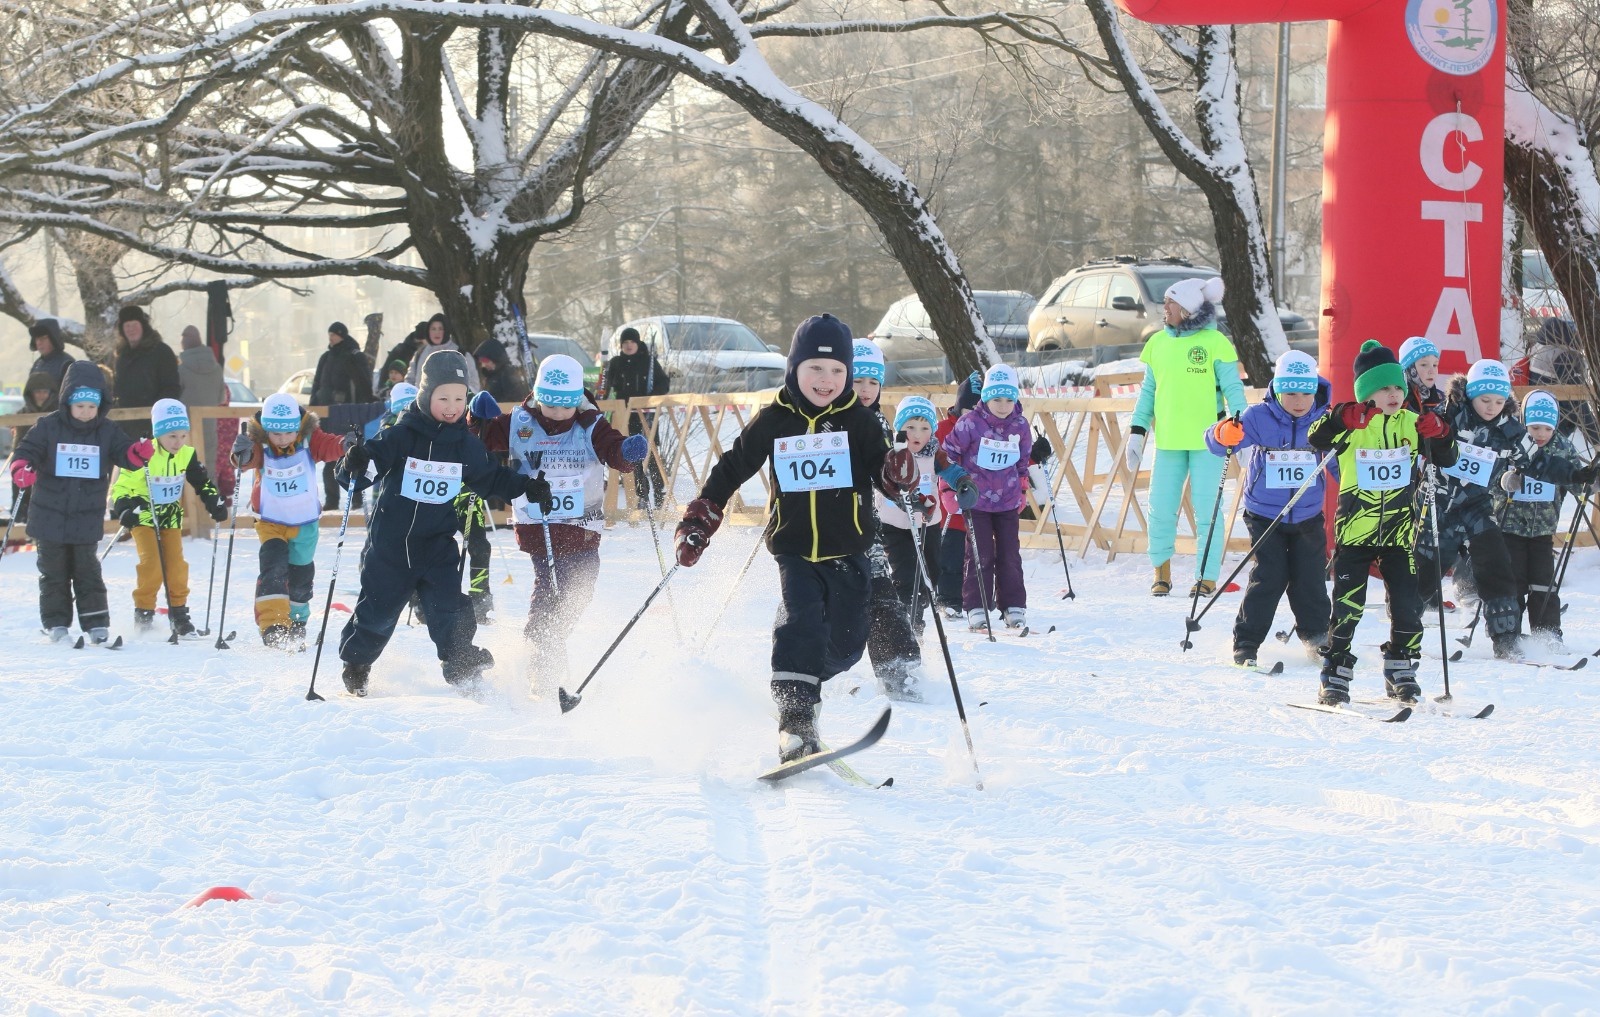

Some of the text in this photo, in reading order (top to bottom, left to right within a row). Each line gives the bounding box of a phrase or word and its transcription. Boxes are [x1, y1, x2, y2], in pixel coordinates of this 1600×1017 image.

[1419, 45, 1490, 73] САНКТ-ПЕТЕРБУРГ
[1419, 112, 1484, 366] СТА
[853, 366, 879, 375] 025
[1281, 381, 1314, 390] 2025
[1478, 382, 1510, 393] 2025
[72, 391, 100, 400] 2025
[538, 392, 572, 404] 2025
[986, 387, 1013, 398] 2025
[904, 407, 934, 420] 2025
[1528, 410, 1557, 420] 2025
[267, 421, 295, 430] 2025
[543, 449, 586, 457] ВЫБОРГСКИЙ
[990, 452, 1009, 465] 111
[67, 457, 90, 470] 115
[789, 458, 836, 481] 104
[1458, 458, 1481, 475] 39
[1278, 467, 1305, 481] 116
[1368, 464, 1402, 481] 103
[162, 485, 181, 498] 113
[275, 480, 298, 493] 114
[414, 478, 449, 497] 108
[551, 495, 575, 511] 06
[1403, 545, 1417, 575] DRIV
